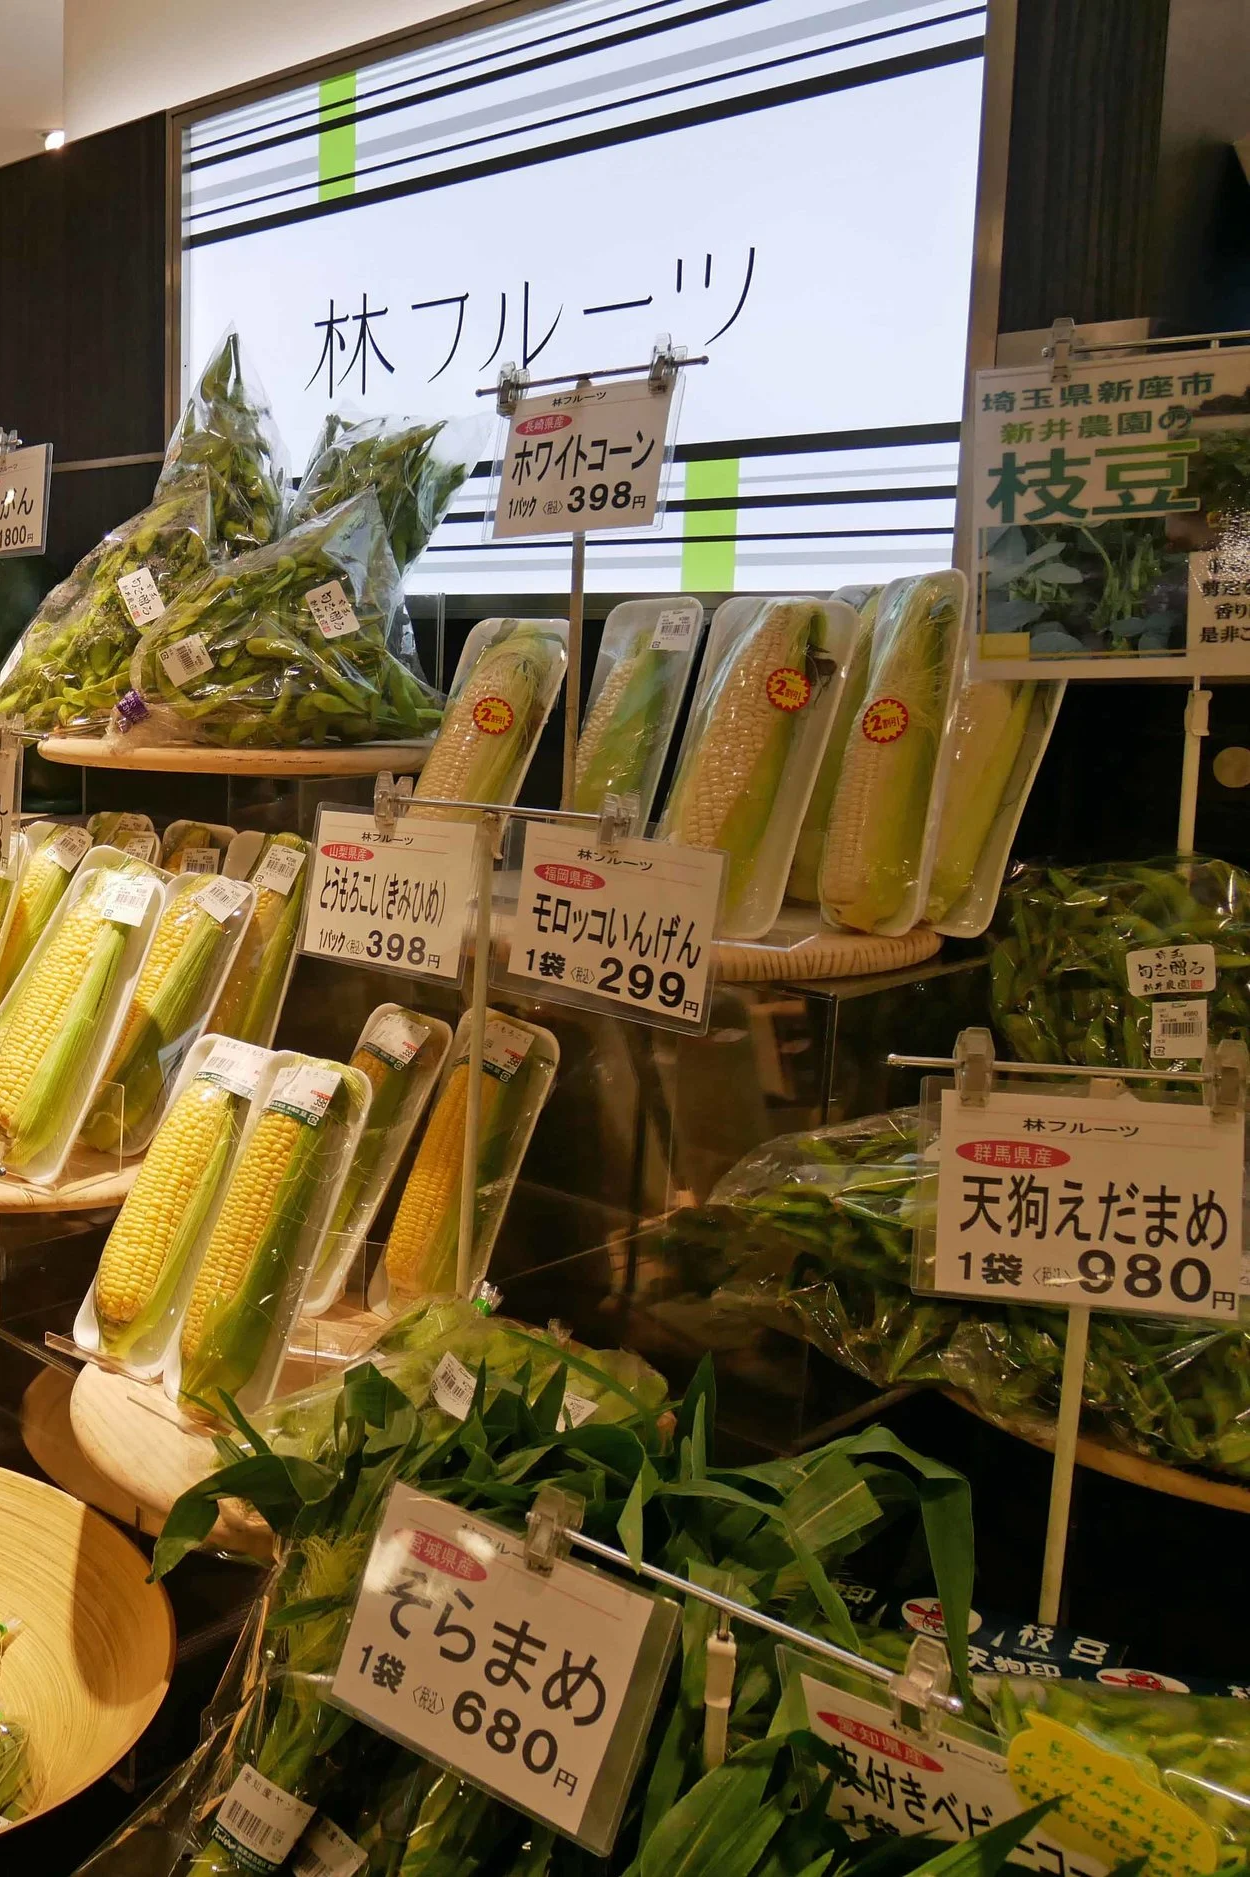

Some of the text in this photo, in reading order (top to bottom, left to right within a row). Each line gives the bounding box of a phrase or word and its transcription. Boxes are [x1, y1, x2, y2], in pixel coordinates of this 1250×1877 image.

[304, 247, 755, 399] 林フルーツ
[553, 391, 607, 407] 林フルーツ
[983, 372, 1215, 414] 埼玉県新座市
[525, 415, 566, 433] 長崎県産
[1001, 405, 1193, 445] 新井農園の
[511, 430, 655, 486] ホワイトコーン
[508, 496, 537, 519] 1パック
[567, 481, 646, 513] 398円
[986, 439, 1201, 524] 枝豆
[0, 525, 34, 549] 1800円
[1215, 602, 1250, 620] 香り
[773, 679, 802, 701] 2割引
[869, 714, 900, 732] 2割引
[329, 846, 367, 861] 山梨県産
[361, 832, 414, 846] 林フルーツ
[319, 865, 446, 928] とうもろこし(きみひめ)
[543, 866, 595, 890] 福岡県産
[319, 928, 346, 953] 1パック
[366, 930, 441, 969] 398円
[532, 892, 702, 970] モロッコいんげん
[525, 948, 566, 981] 1袋
[597, 957, 700, 1019] 299円
[1138, 959, 1205, 979] 旬を贈る
[1022, 1117, 1140, 1138] 林フルーツ
[973, 1143, 1053, 1167] 群馬県産
[959, 1173, 1228, 1251] 天狗えだまめ
[958, 1251, 1023, 1287] 1袋
[1077, 1249, 1236, 1311] 980円
[410, 1532, 475, 1578] 宮城県産
[386, 1565, 606, 1727] そらまめ
[967, 1645, 1063, 1679] 天狗印
[1017, 1622, 1111, 1665] 枝豆
[359, 1644, 407, 1695] 1袋
[452, 1690, 579, 1798] 680円
